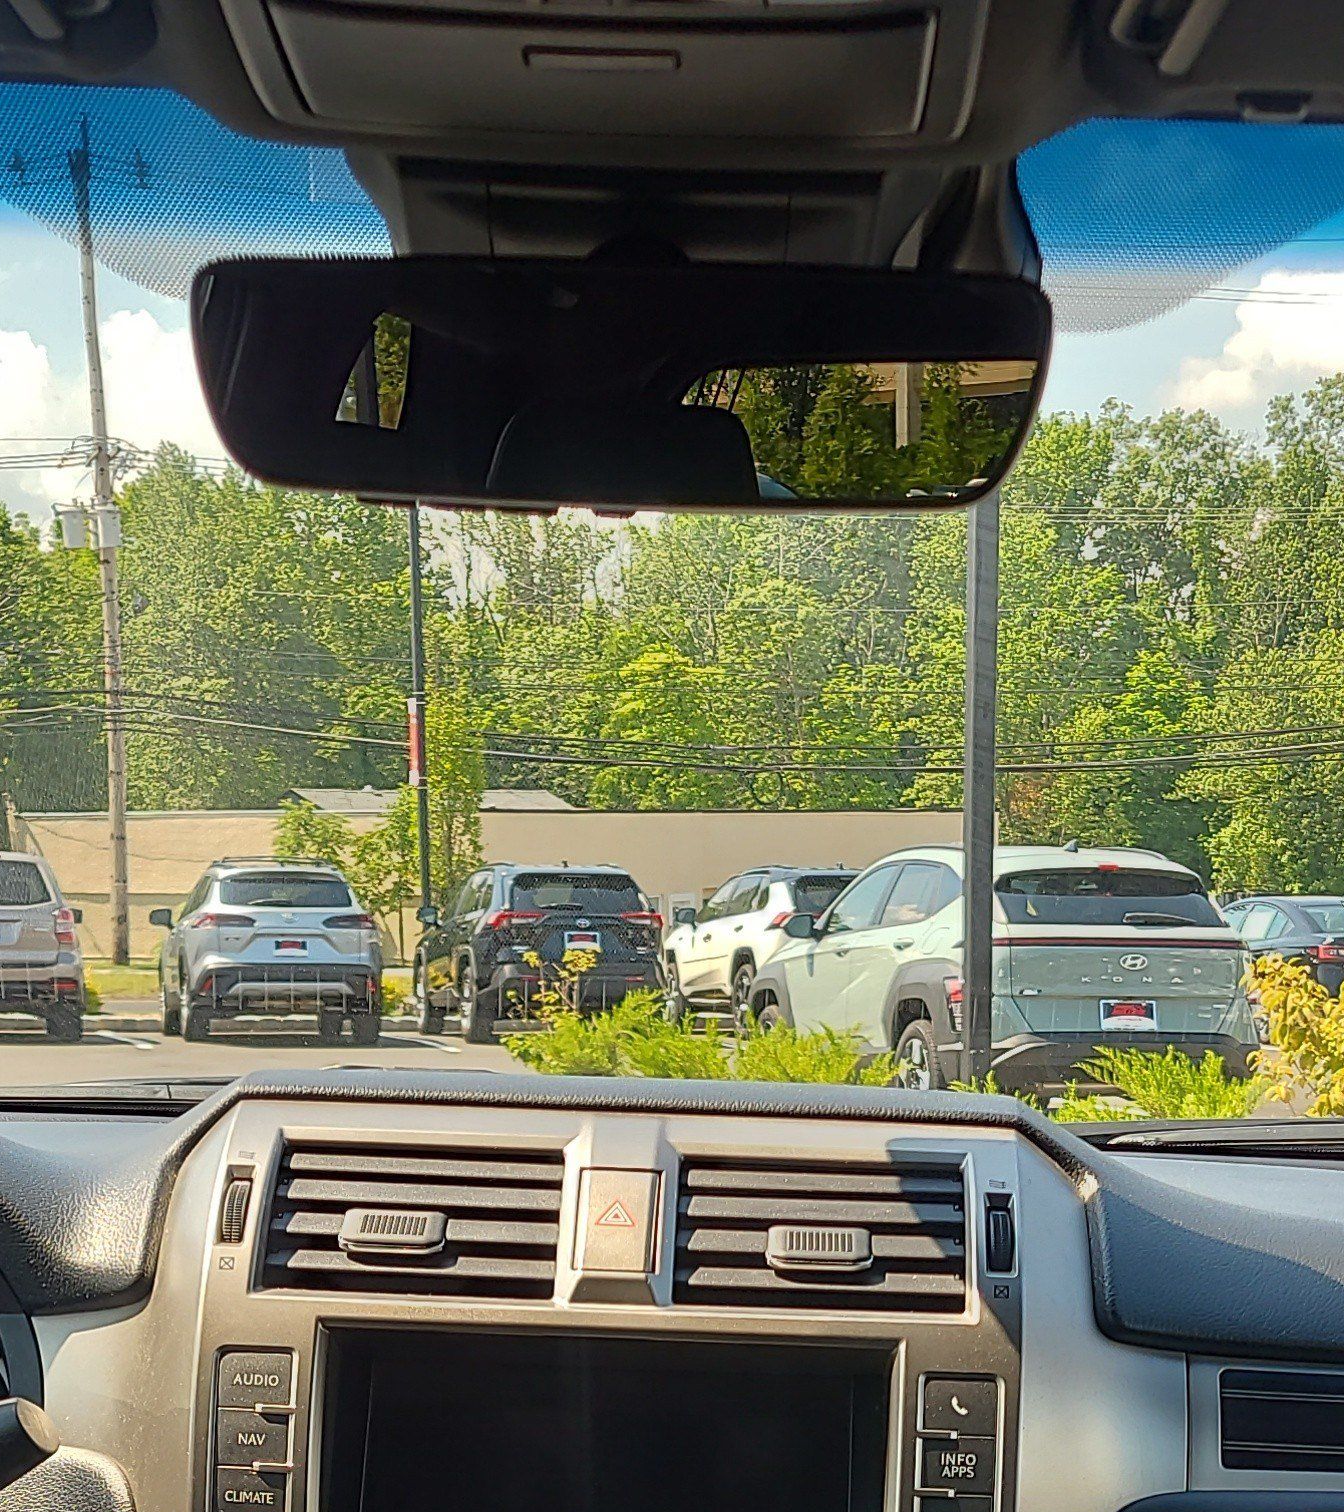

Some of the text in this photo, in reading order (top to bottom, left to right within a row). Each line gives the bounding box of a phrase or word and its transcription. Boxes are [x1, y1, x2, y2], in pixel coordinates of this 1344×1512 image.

[233, 1373, 280, 1387] AUDIO
[238, 1433, 266, 1446] NAV
[941, 1453, 977, 1466] INFO
[941, 1466, 975, 1478] APPS
[224, 1490, 275, 1505] CLIMATE
